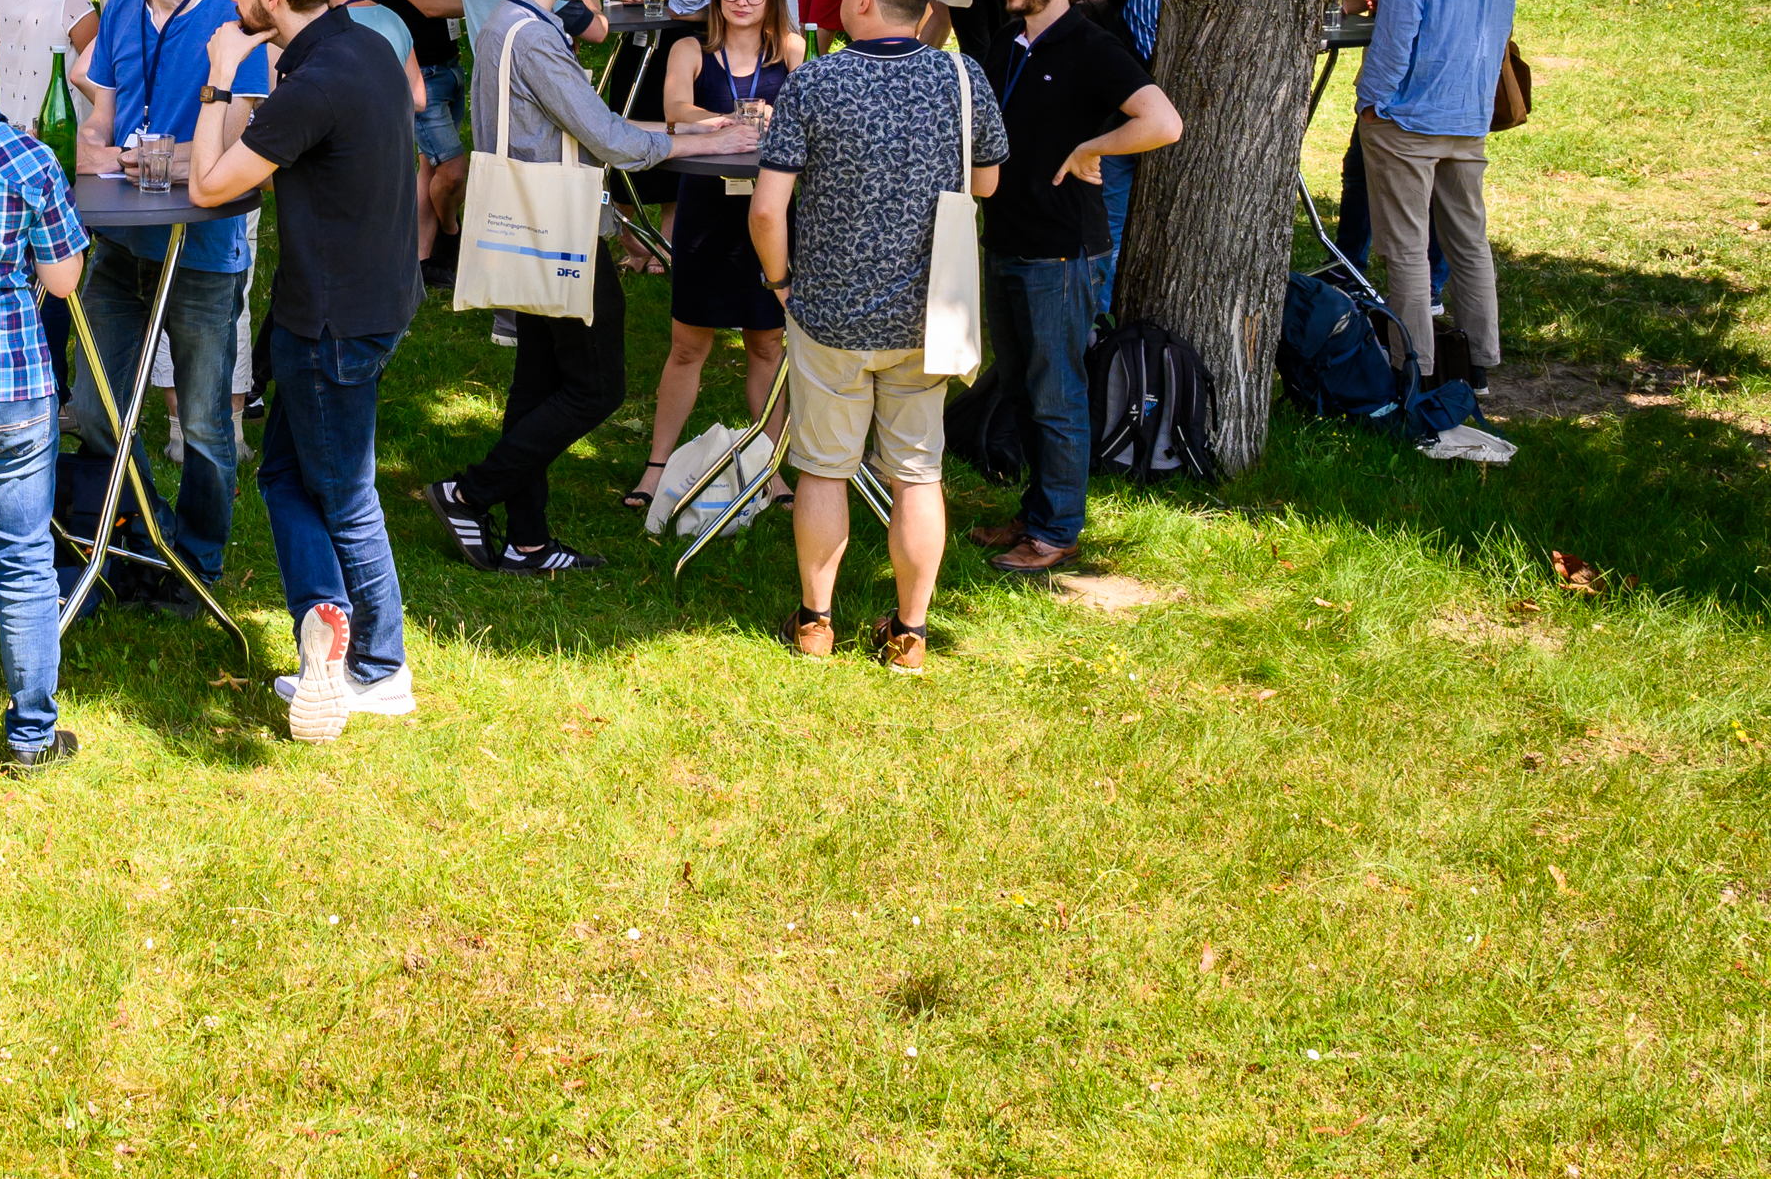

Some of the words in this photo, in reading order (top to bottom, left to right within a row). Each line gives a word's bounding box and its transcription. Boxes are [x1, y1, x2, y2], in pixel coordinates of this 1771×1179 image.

[488, 212, 513, 222] Deutsche
[487, 219, 549, 234] Forschungsgemeinschaft
[557, 267, 581, 279] DFG
